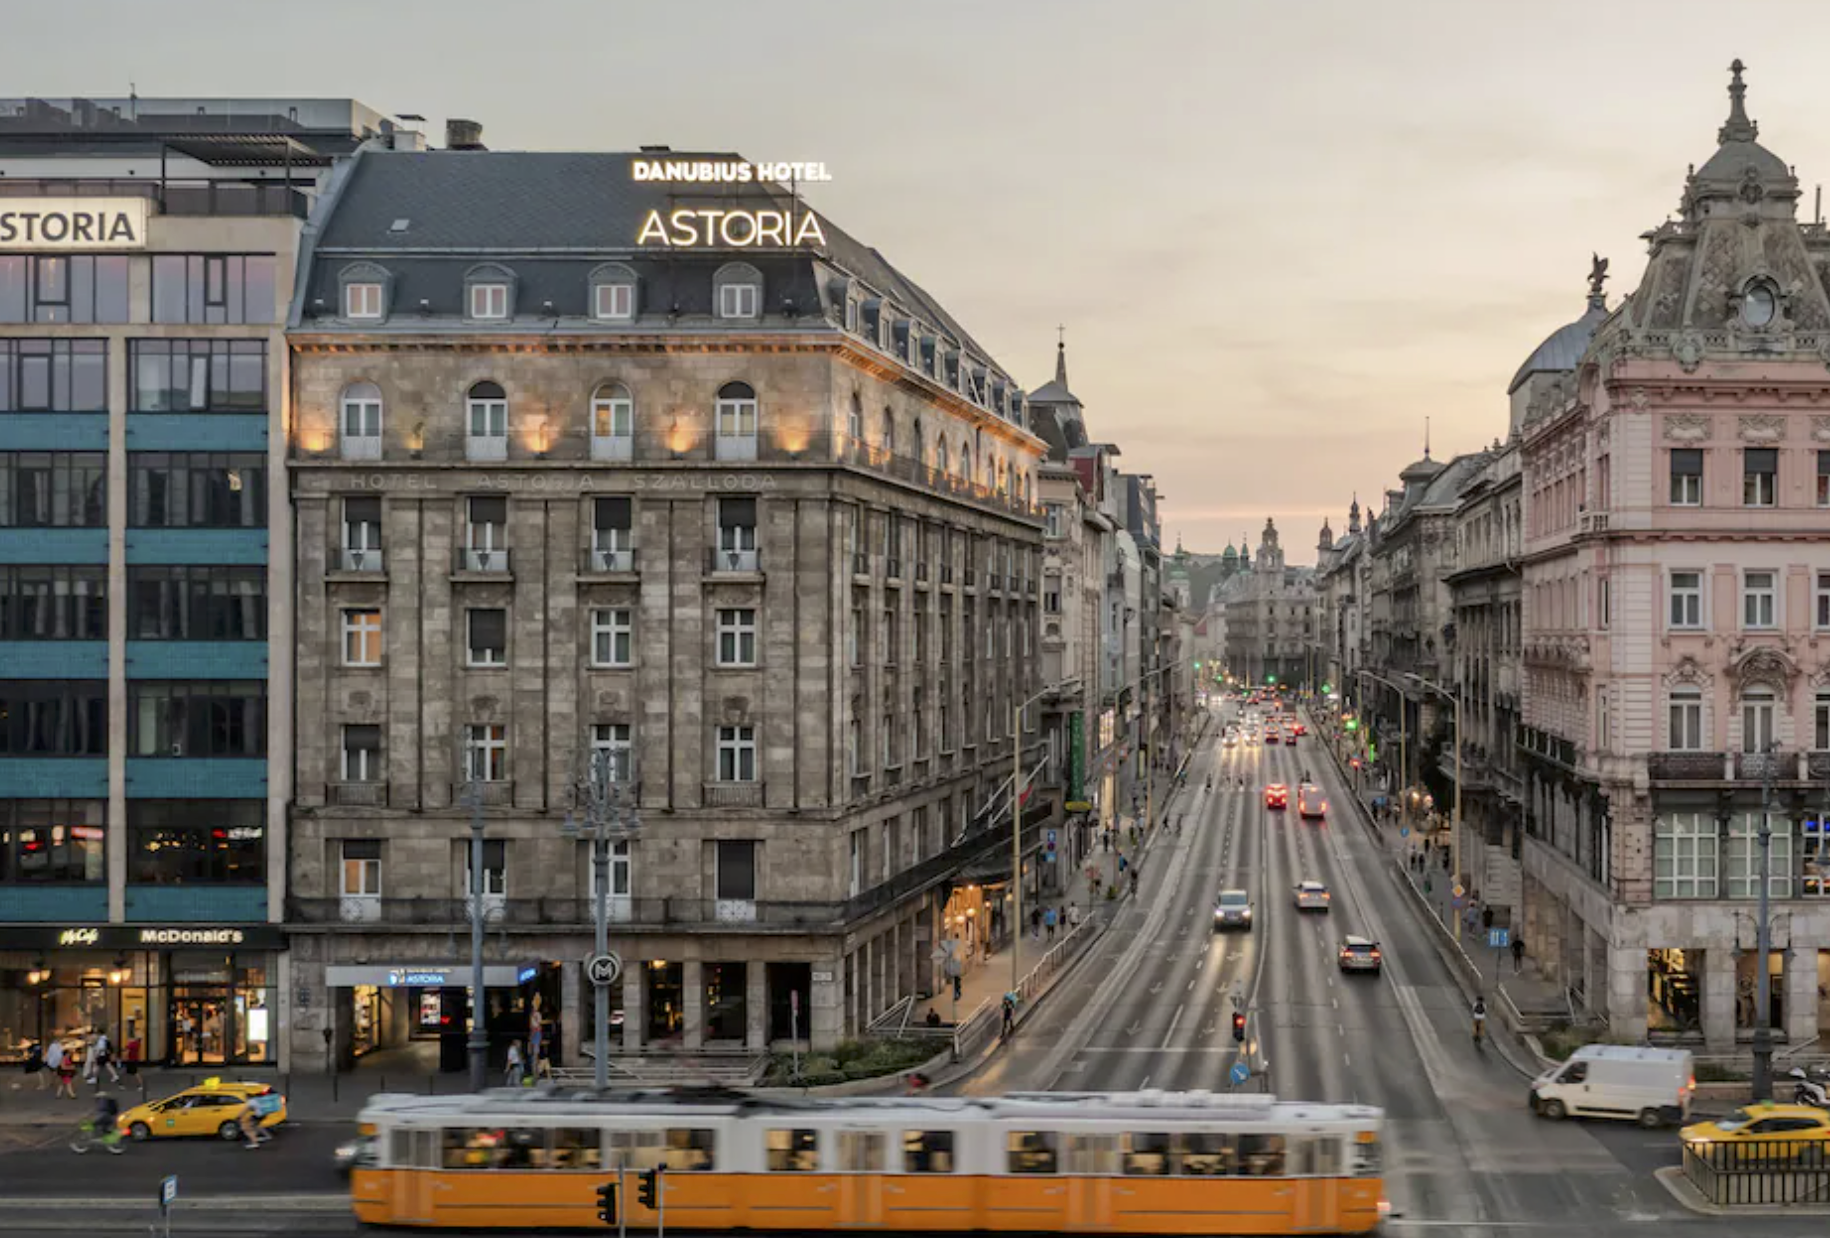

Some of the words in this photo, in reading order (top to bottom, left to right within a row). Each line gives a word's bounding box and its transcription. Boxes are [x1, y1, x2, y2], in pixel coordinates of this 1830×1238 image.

[632, 161, 752, 182] DANUBIUS
[756, 161, 832, 182] HOTEL
[0, 212, 136, 242] STORIA
[637, 209, 827, 247] ASTORIA
[350, 473, 438, 489] HOTEL
[476, 473, 595, 489] ASTORIA
[140, 929, 243, 943] McDonald's
[595, 961, 612, 979] M
